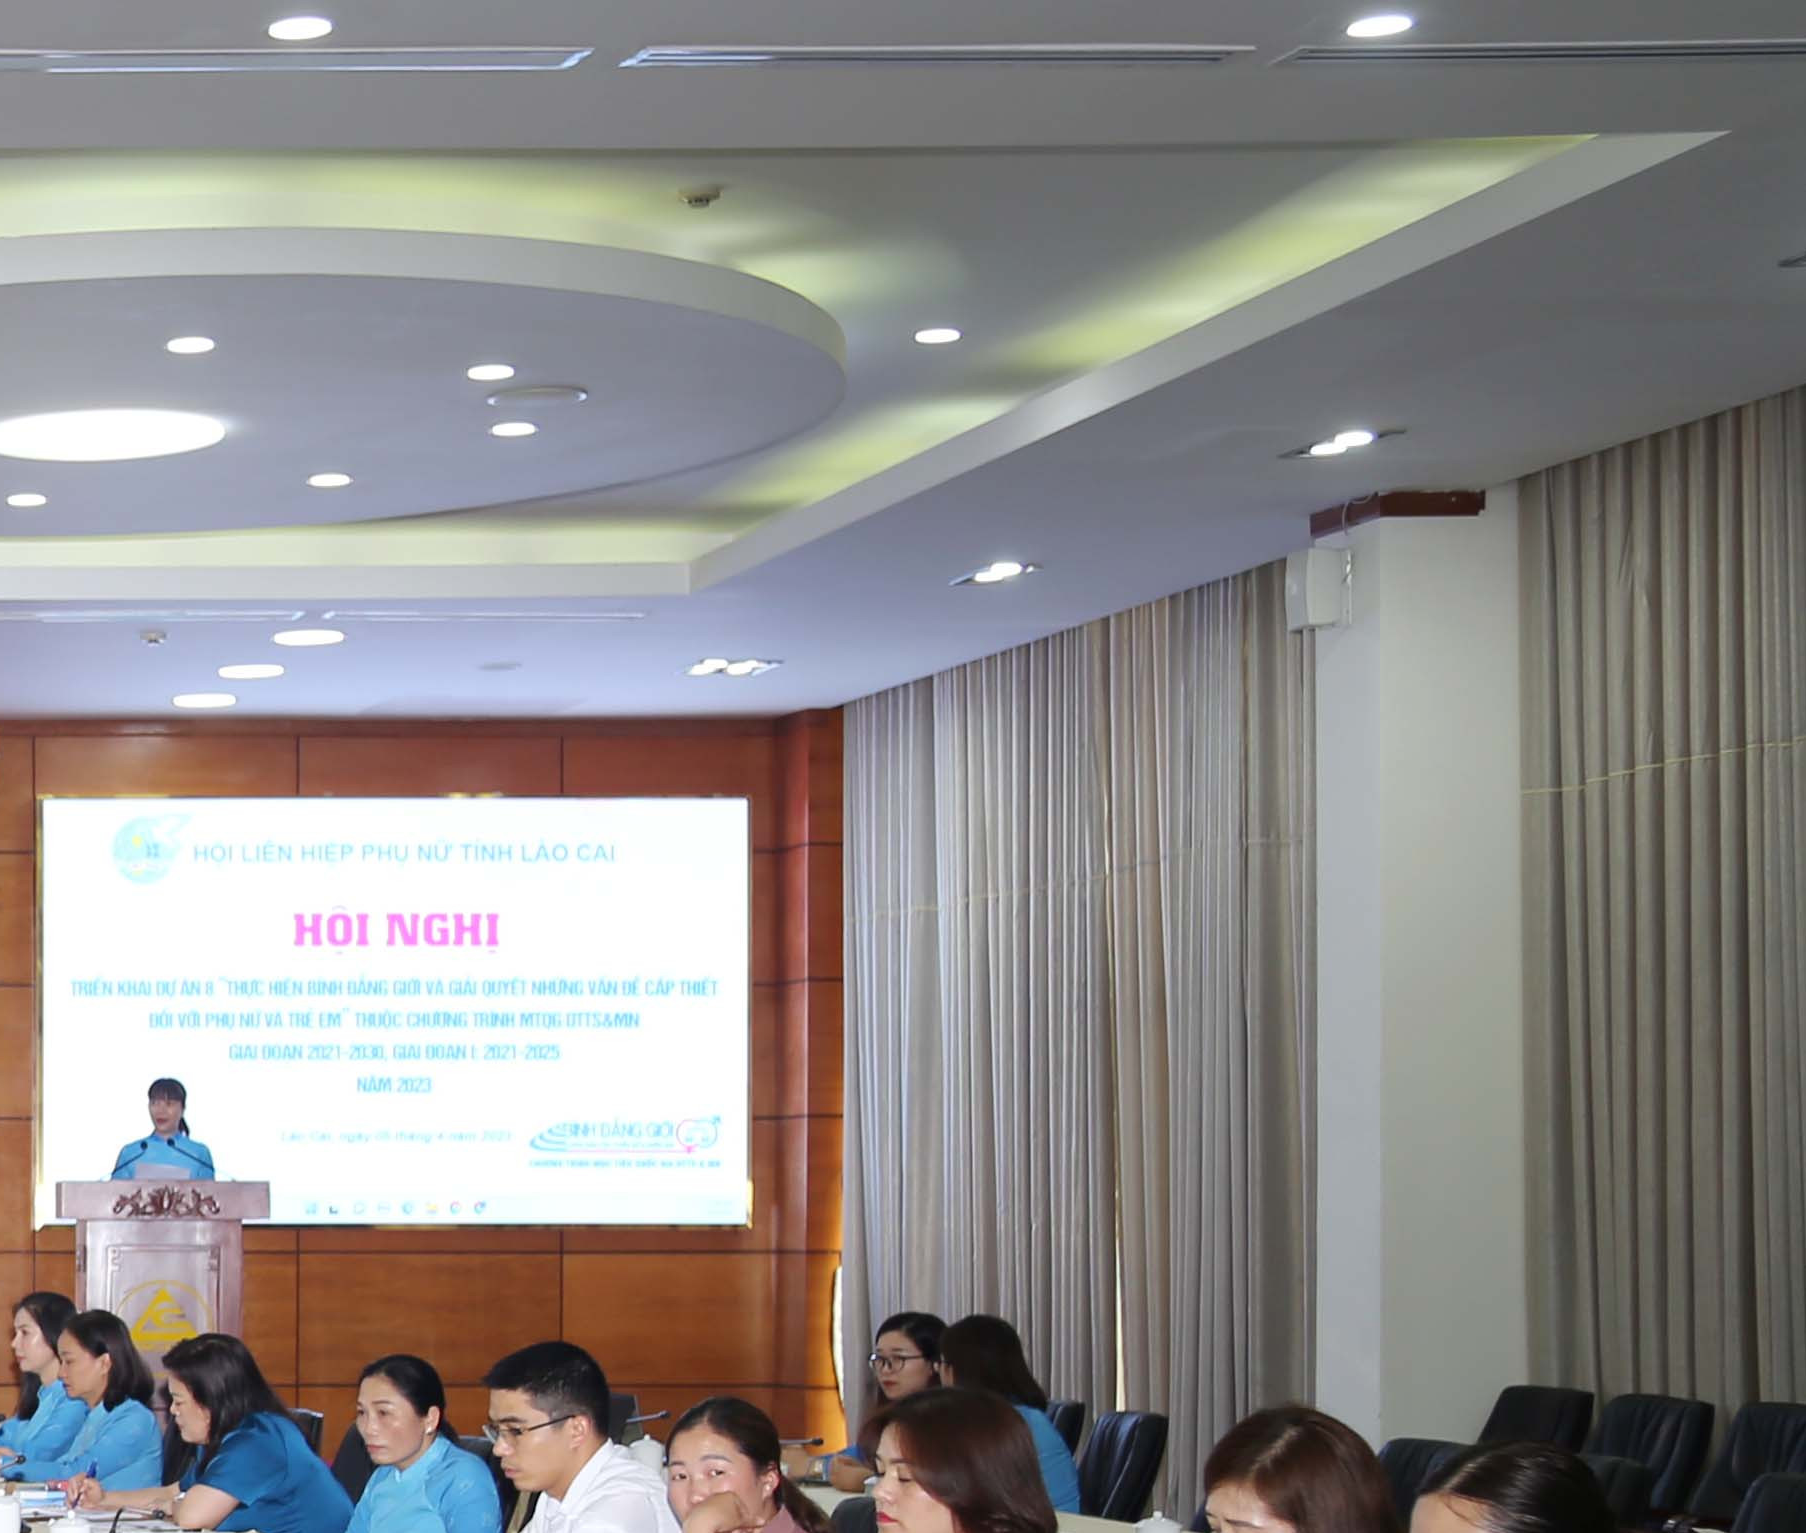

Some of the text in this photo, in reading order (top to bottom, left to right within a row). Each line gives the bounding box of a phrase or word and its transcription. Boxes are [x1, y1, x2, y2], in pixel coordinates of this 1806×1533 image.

[577, 844, 615, 862] CAI
[293, 905, 499, 955] HỘI NGHỊ
[397, 1077, 431, 1093] 2023
